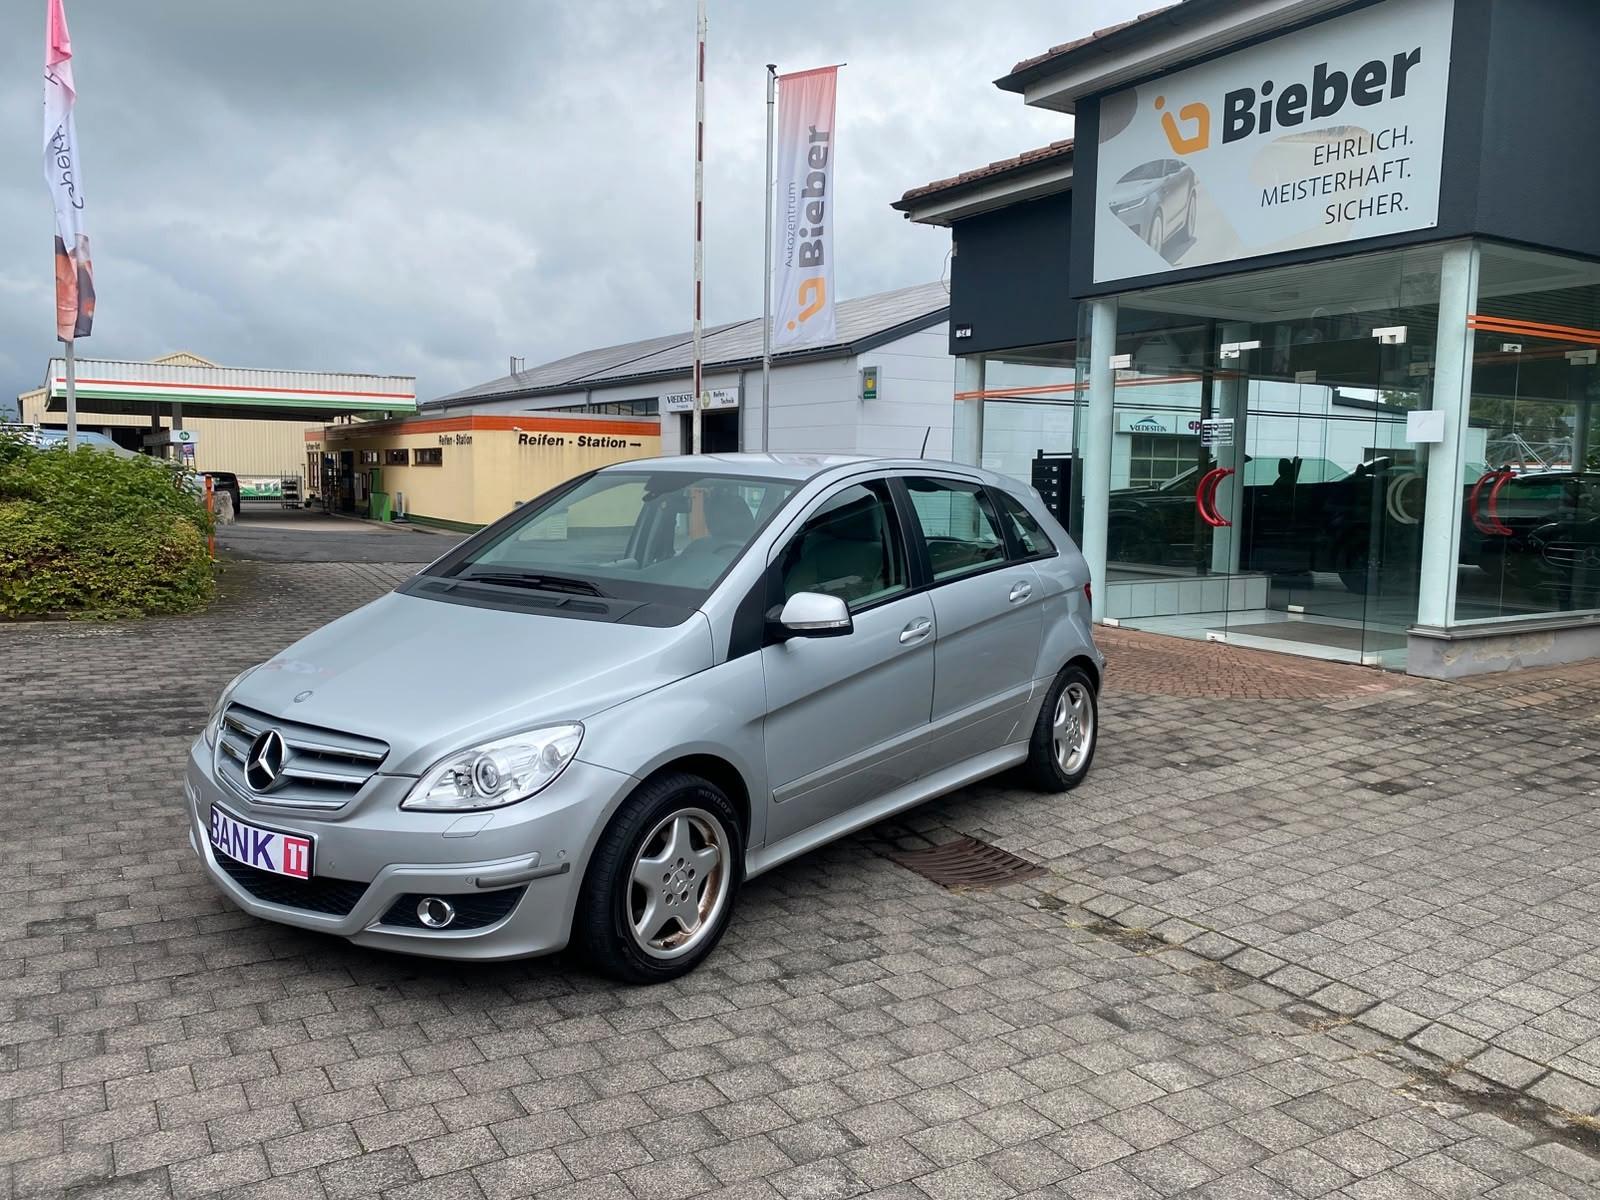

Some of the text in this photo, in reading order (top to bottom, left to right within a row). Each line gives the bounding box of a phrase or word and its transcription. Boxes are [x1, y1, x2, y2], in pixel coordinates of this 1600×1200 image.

[1222, 46, 1421, 144] Bieber
[1313, 125, 1413, 166] EHRLICH.
[799, 125, 830, 268] Bieber
[1261, 157, 1411, 207] MEISTERHAFT.
[785, 182, 797, 268] Autozentrum
[1325, 192, 1409, 224] SICHER.
[439, 434, 452, 446] Reifen
[456, 433, 472, 446] Station
[518, 433, 564, 446] Reifen
[577, 435, 627, 449] Station
[211, 810, 275, 871] BANK
